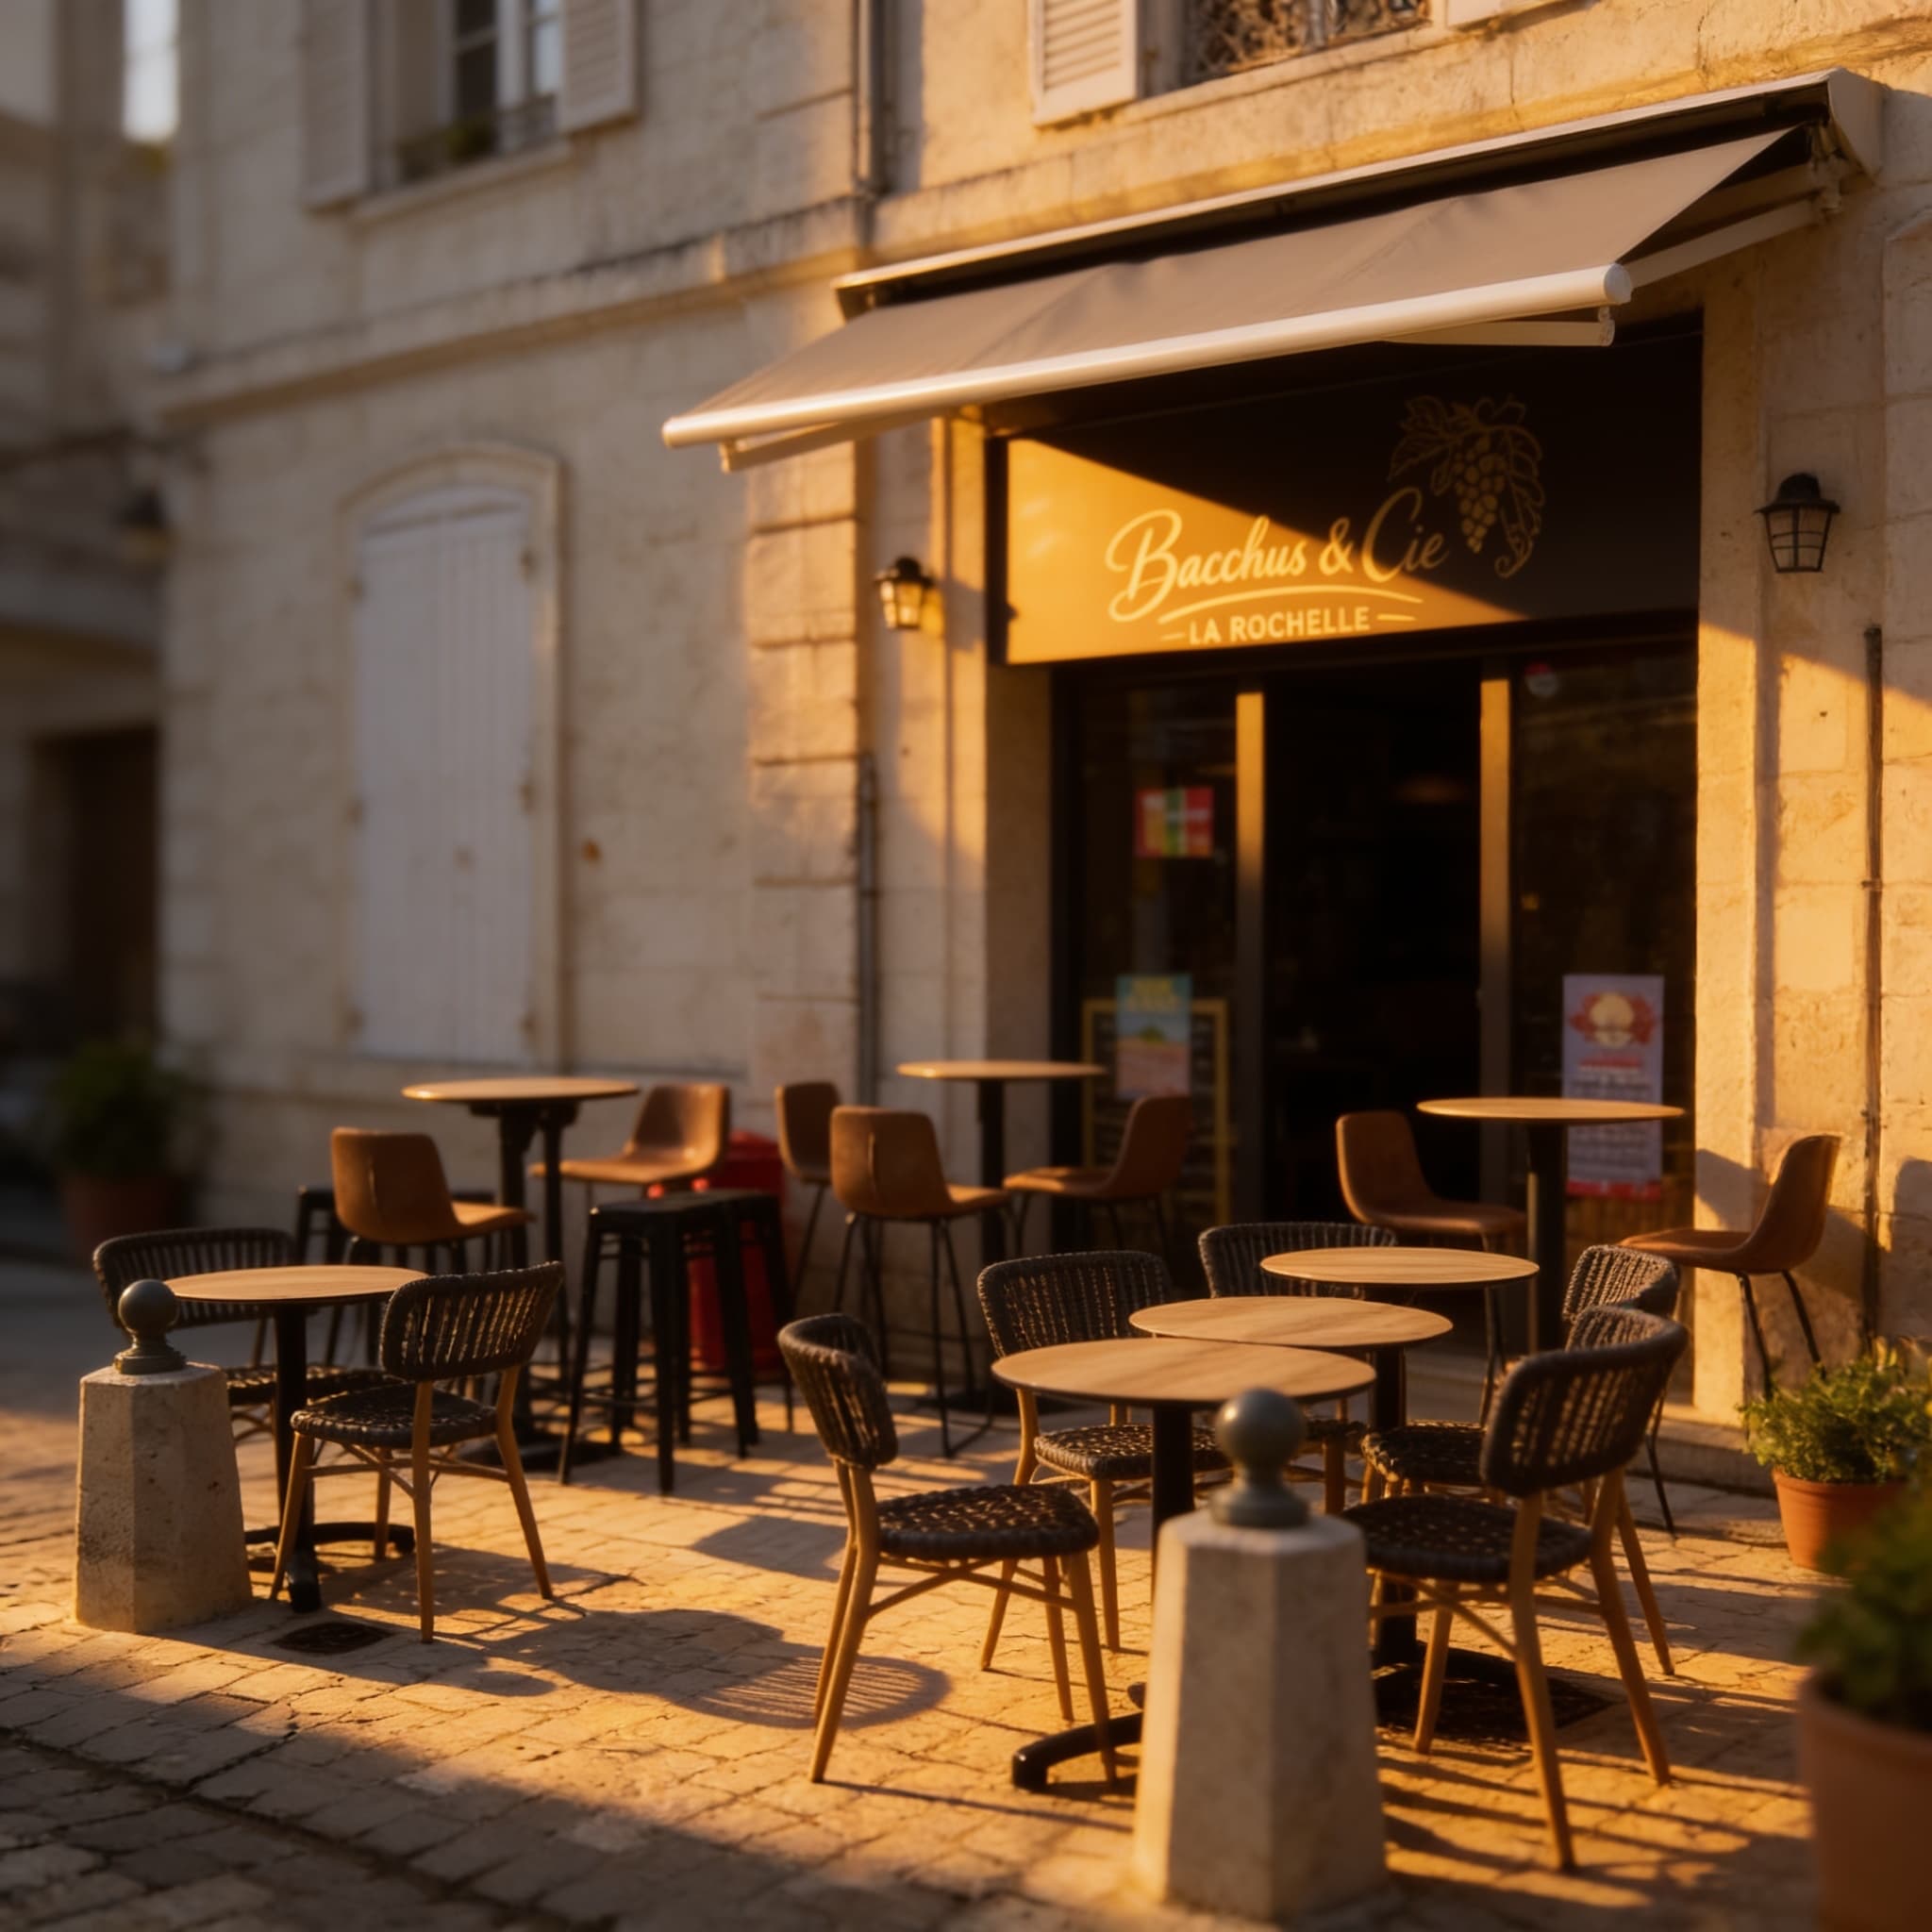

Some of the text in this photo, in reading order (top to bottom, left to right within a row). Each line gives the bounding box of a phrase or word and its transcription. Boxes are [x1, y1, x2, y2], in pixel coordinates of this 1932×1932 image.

[1105, 487, 1450, 623] Bacchus & Cie
[1188, 607, 1371, 645] LA ROCHELLE
